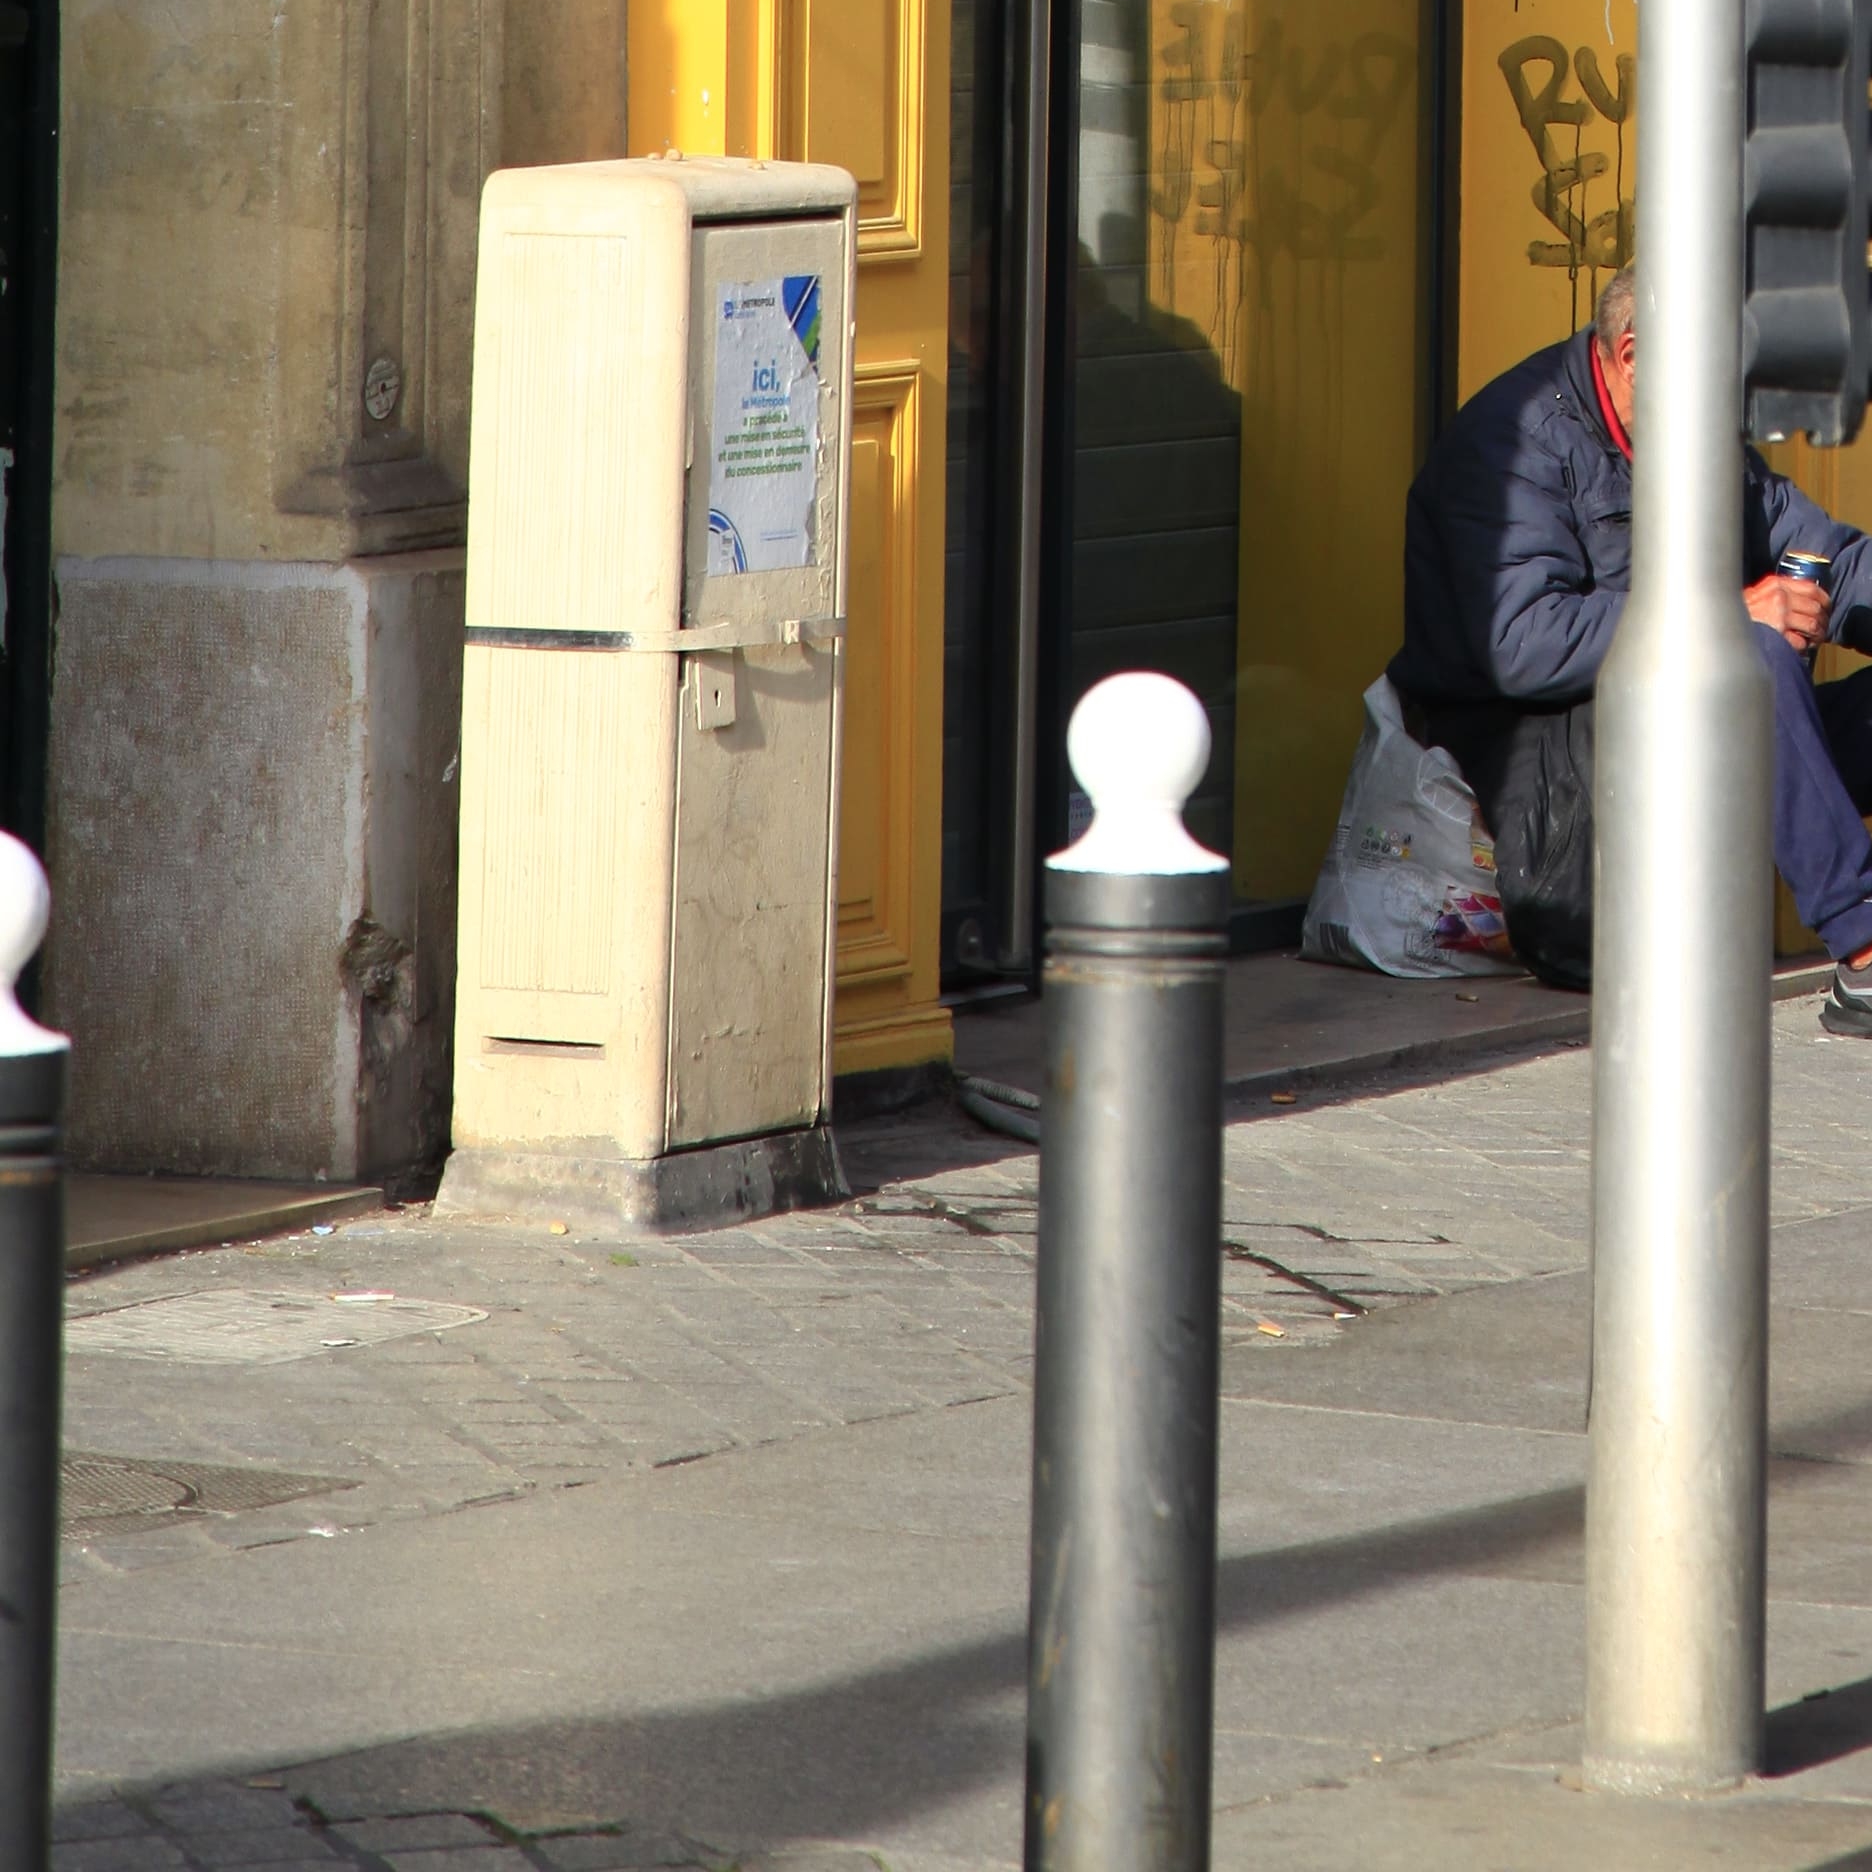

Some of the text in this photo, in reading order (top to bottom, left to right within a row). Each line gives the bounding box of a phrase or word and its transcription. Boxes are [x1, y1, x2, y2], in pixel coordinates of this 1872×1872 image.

[752, 359, 781, 392] ici,
[725, 432, 739, 445] une
[741, 430, 760, 444] mise
[718, 450, 726, 463] et
[743, 446, 763, 460] mise
[764, 446, 775, 458] en
[725, 466, 735, 479] du
